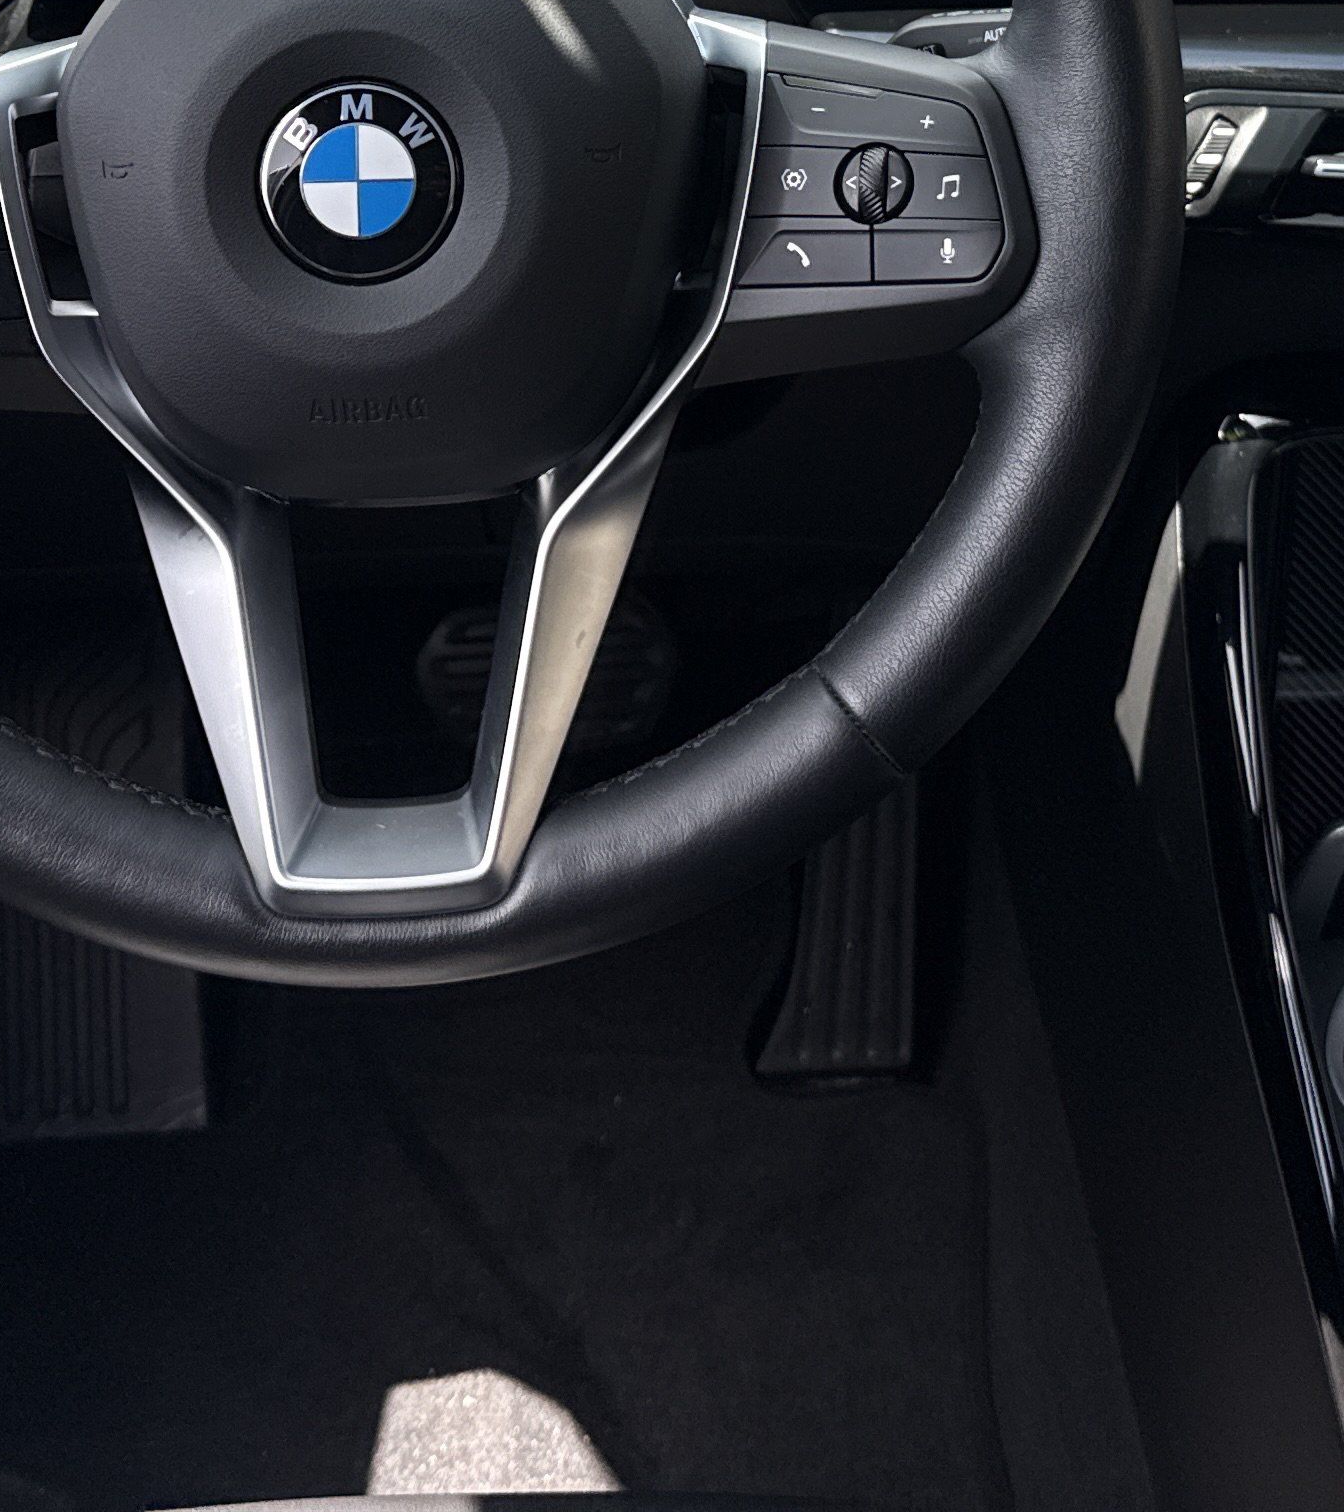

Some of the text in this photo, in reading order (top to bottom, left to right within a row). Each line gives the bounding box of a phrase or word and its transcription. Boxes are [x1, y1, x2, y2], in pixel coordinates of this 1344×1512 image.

[983, 27, 1007, 43] AUT
[282, 93, 435, 154] BMW
[307, 397, 430, 425] AIRBAG
